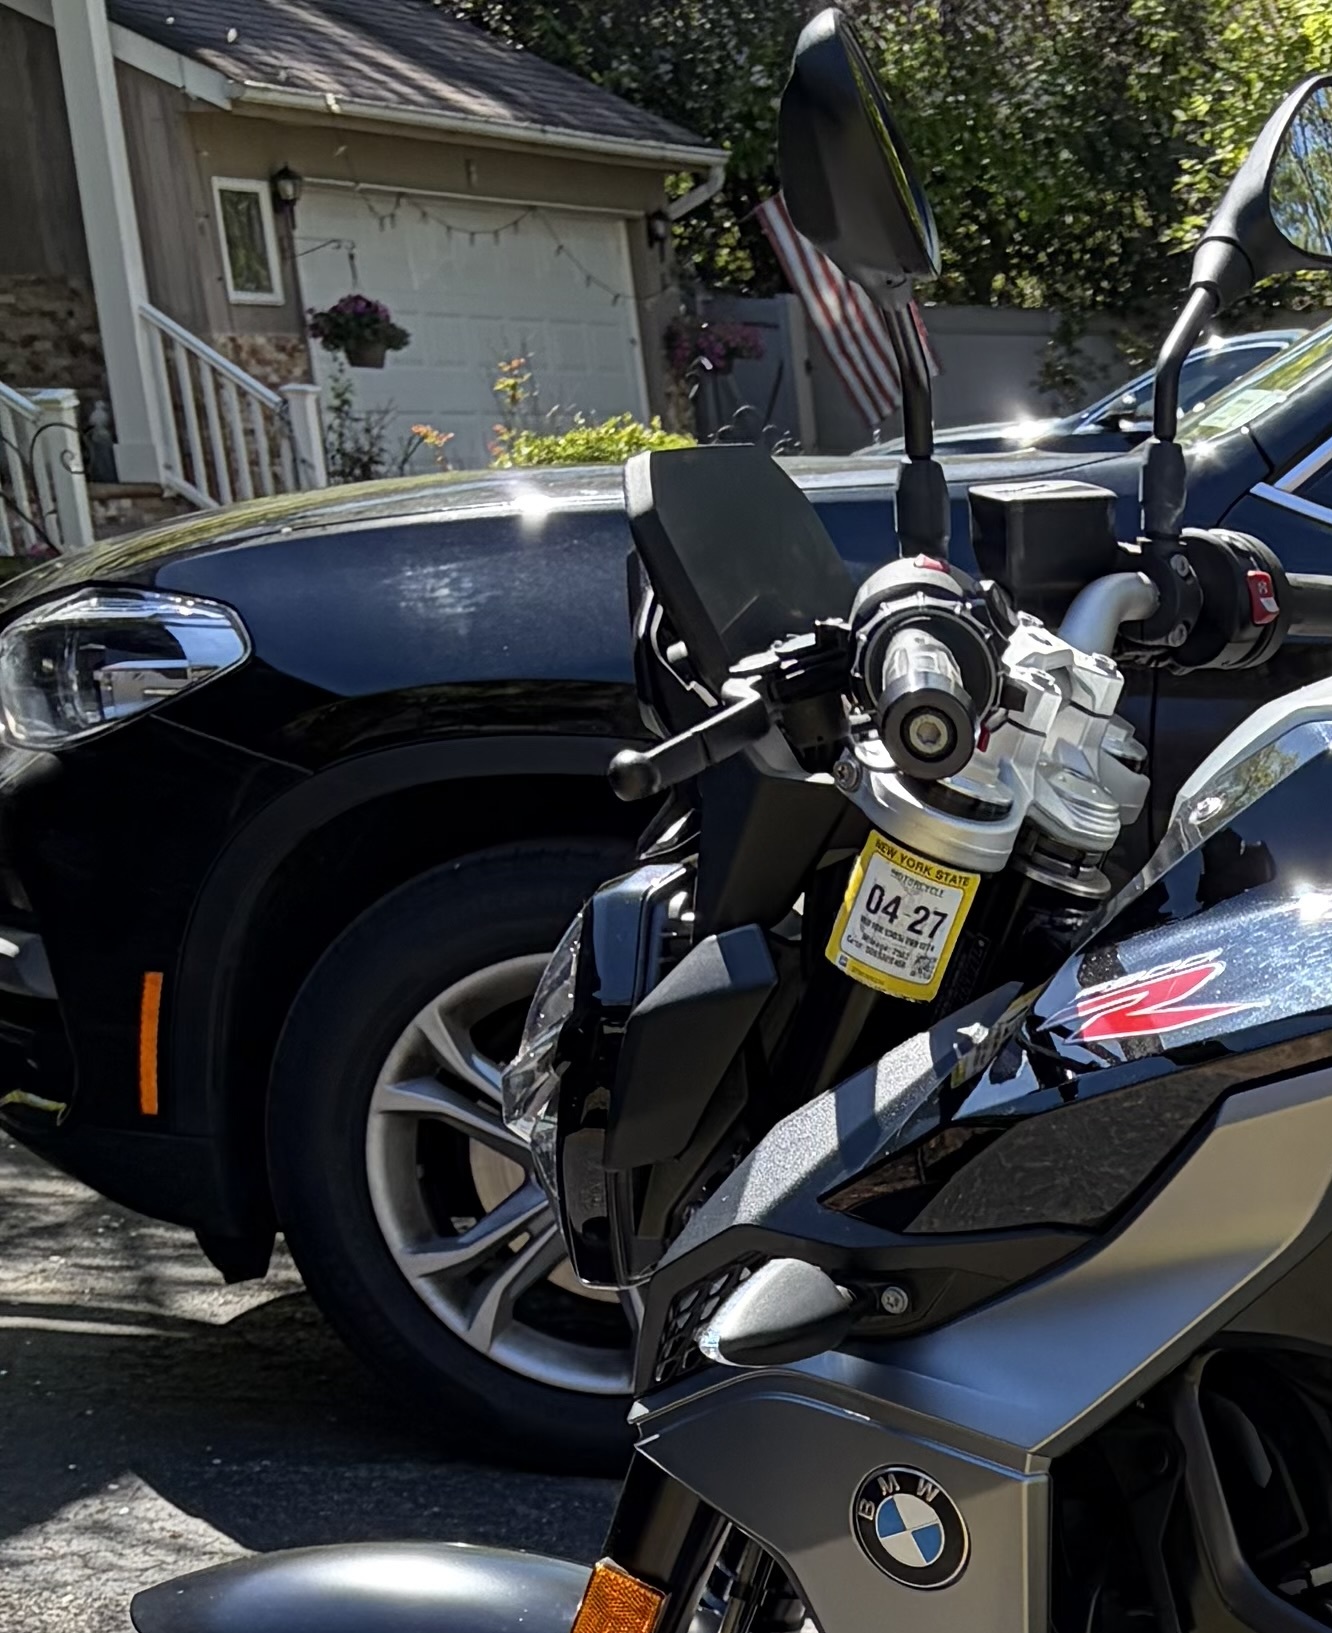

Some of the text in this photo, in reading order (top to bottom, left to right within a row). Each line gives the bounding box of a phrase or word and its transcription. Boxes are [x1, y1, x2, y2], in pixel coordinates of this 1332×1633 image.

[875, 839, 971, 887] NEW YORK STATE
[858, 1473, 940, 1521] BMW
